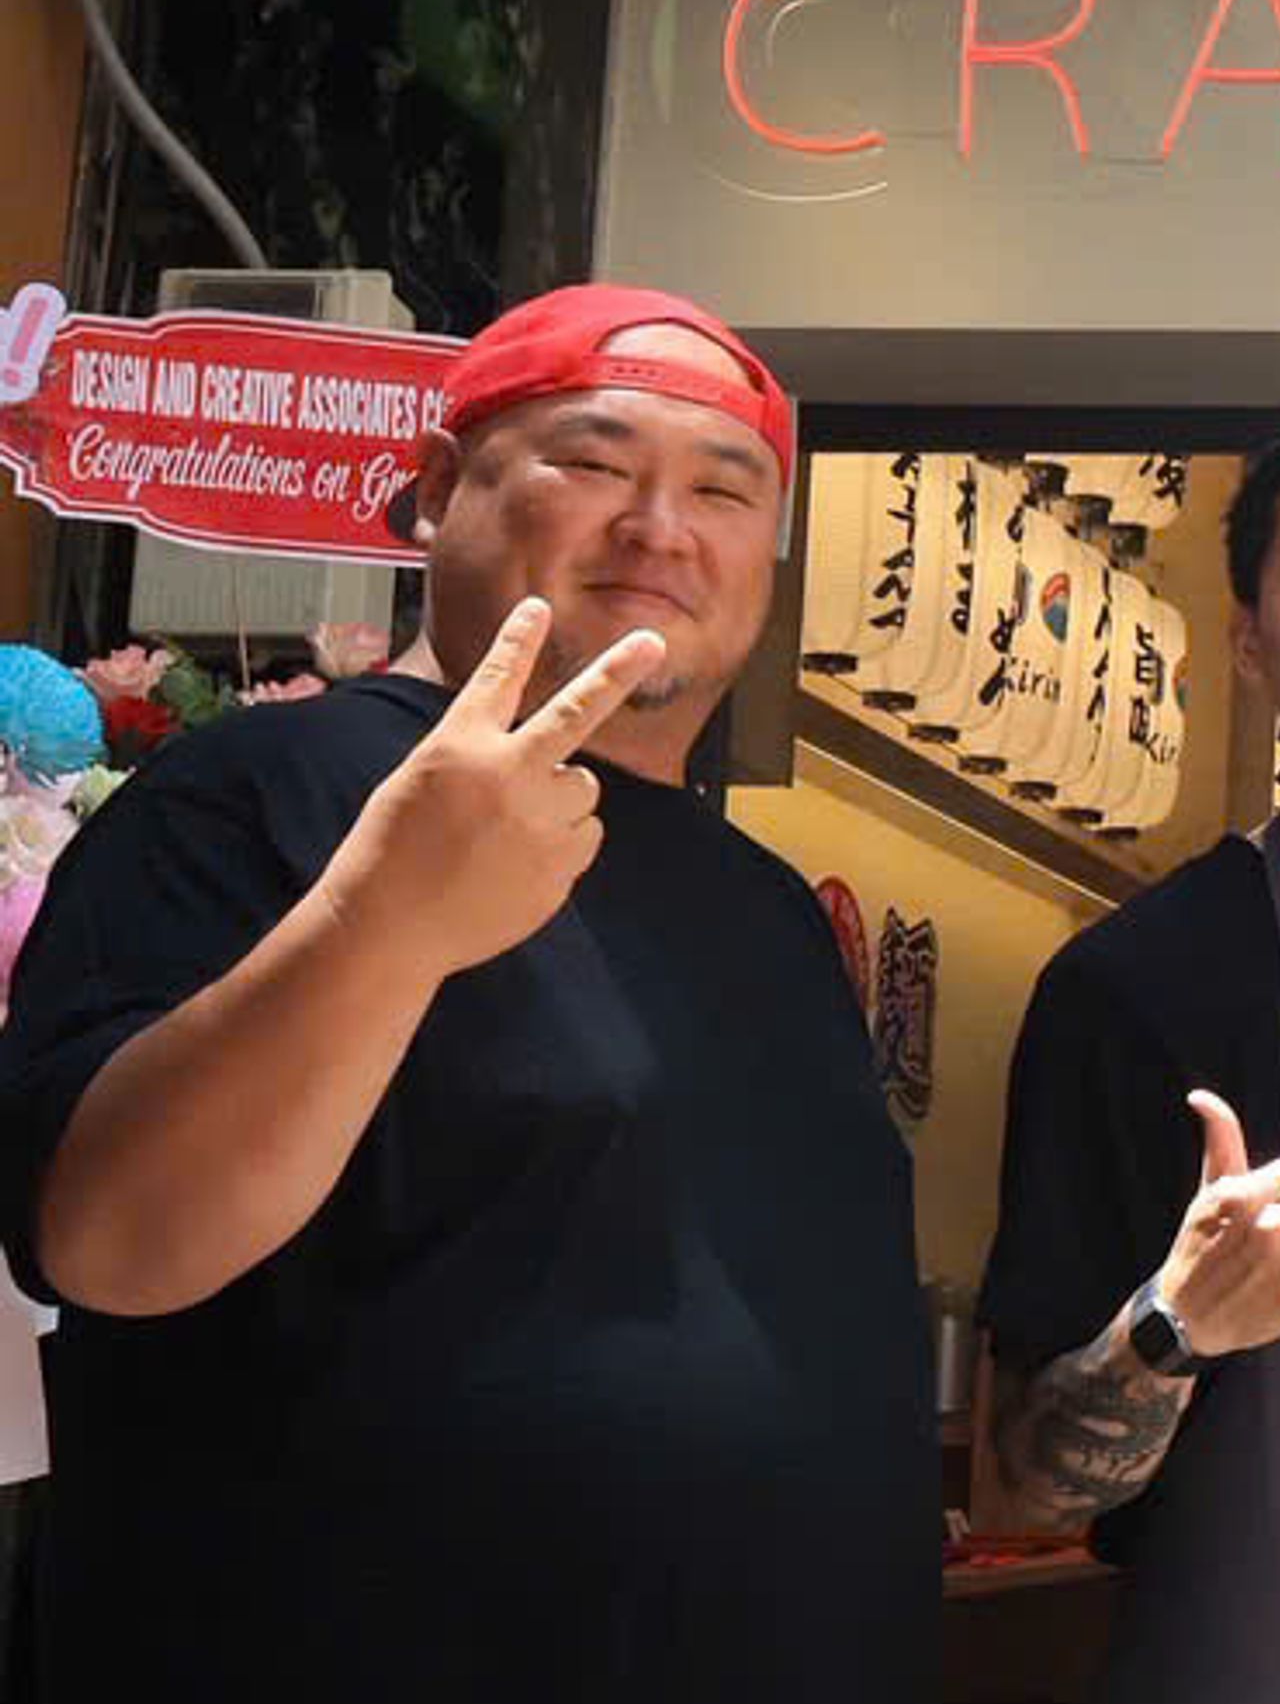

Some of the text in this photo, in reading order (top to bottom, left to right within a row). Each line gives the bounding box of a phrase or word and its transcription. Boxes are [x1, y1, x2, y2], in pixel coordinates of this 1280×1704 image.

[71, 348, 150, 416] DESIGN
[151, 359, 197, 420] AND
[201, 365, 295, 430] CREATIVE
[297, 375, 418, 441] ASSOCIATES
[67, 422, 418, 523] Congratulations on Gr
